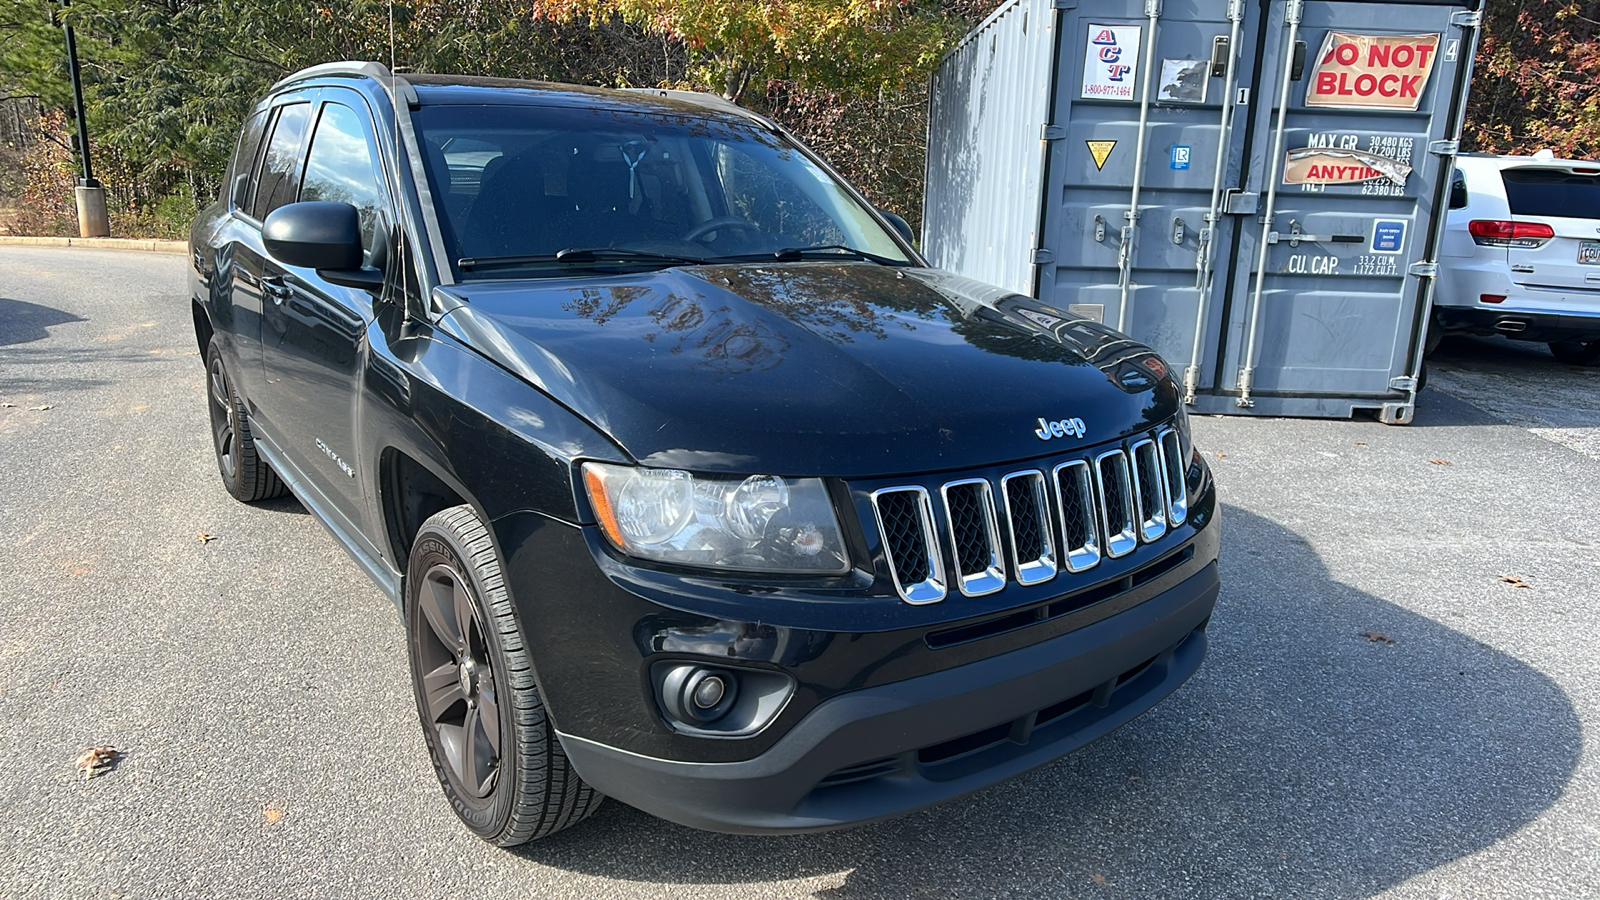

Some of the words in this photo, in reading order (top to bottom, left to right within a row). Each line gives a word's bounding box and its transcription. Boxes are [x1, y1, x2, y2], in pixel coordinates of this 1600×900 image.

[1367, 44, 1434, 69] NOT
[1446, 41, 1456, 59] 4
[1084, 84, 1131, 96] 1-800-977-1464
[1316, 71, 1423, 98] BLOCK
[1239, 89, 1246, 103] 1
[1307, 133, 1337, 148] MAX
[1340, 135, 1359, 150] GR
[1369, 136, 1397, 147] 30.480
[1398, 137, 1413, 148] KGS
[1397, 147, 1411, 158] LBS
[1306, 164, 1385, 180] ANYTIM
[1361, 185, 1390, 196] 62.380
[1390, 187, 1405, 197] LBS
[1288, 254, 1308, 273] CU.
[1311, 255, 1339, 275] CAP.
[1358, 255, 1376, 265] 33.2
[1377, 255, 1397, 266] CU.M.
[1353, 264, 1375, 275] 1.172
[1375, 265, 1398, 275] CU.FT.
[1034, 417, 1087, 441] Jeep
